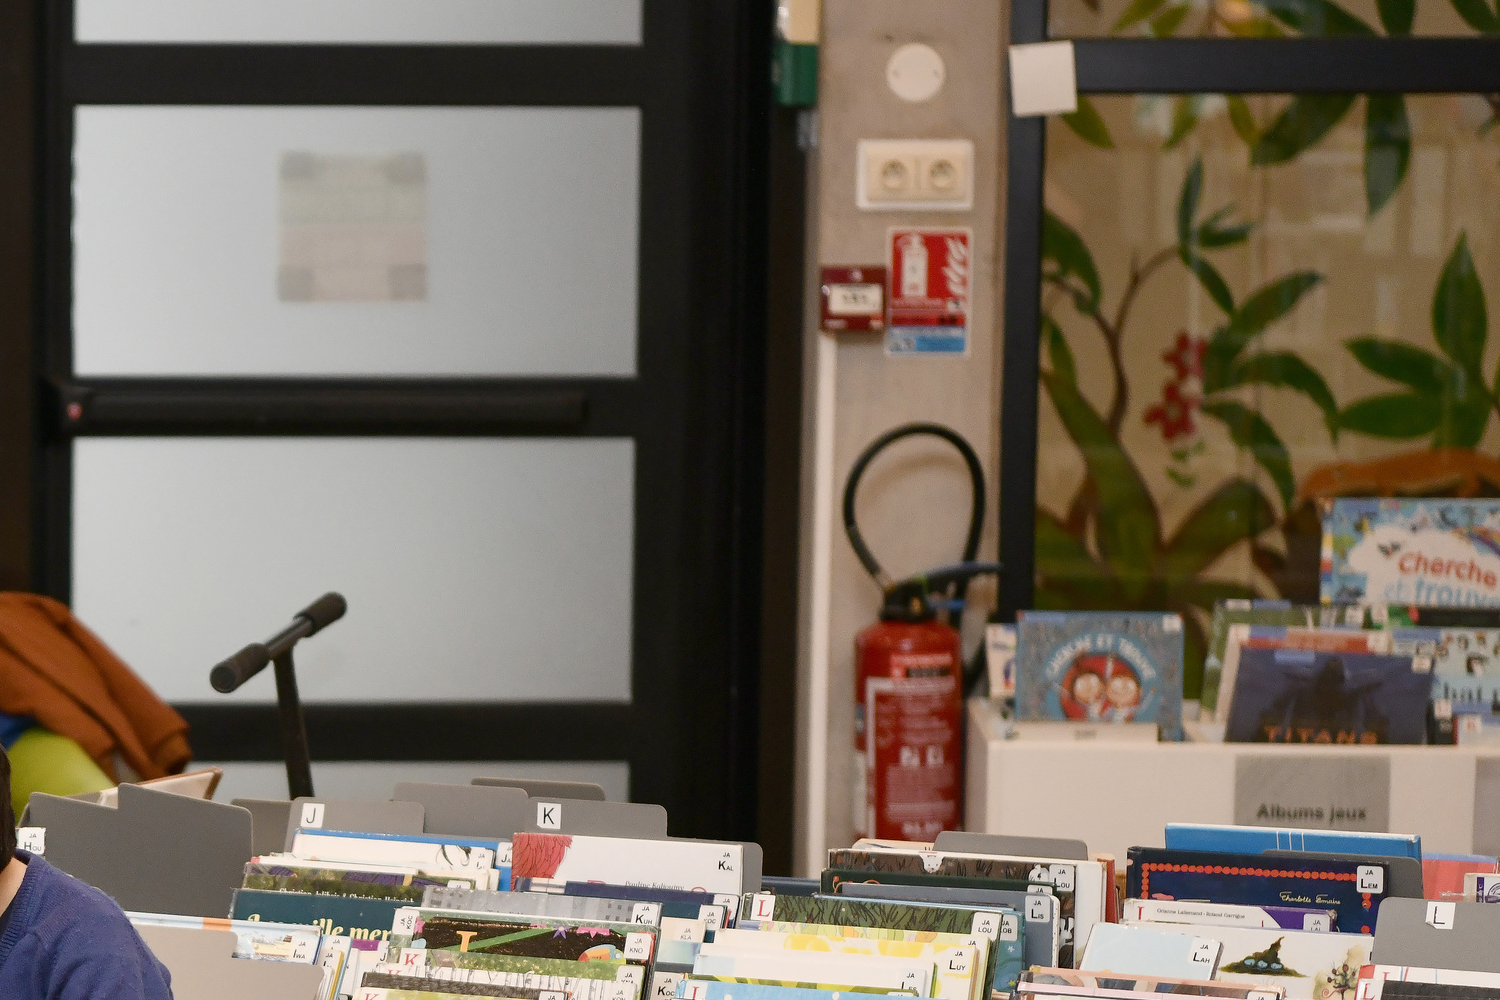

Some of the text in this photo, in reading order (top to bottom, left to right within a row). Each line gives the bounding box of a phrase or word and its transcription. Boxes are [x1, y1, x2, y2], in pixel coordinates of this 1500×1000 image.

[1398, 551, 1497, 590] Cherche
[1264, 725, 1378, 745] TITANS
[306, 807, 316, 824] J
[543, 807, 555, 825] K
[1257, 802, 1366, 824] Albums jeux
[718, 861, 734, 871] KAL
[1361, 878, 1378, 889] LEM
[757, 900, 771, 918] L
[1031, 909, 1044, 920] LIS
[1433, 905, 1445, 925] L
[949, 960, 965, 971] LUY
[1362, 983, 1375, 1000] L
